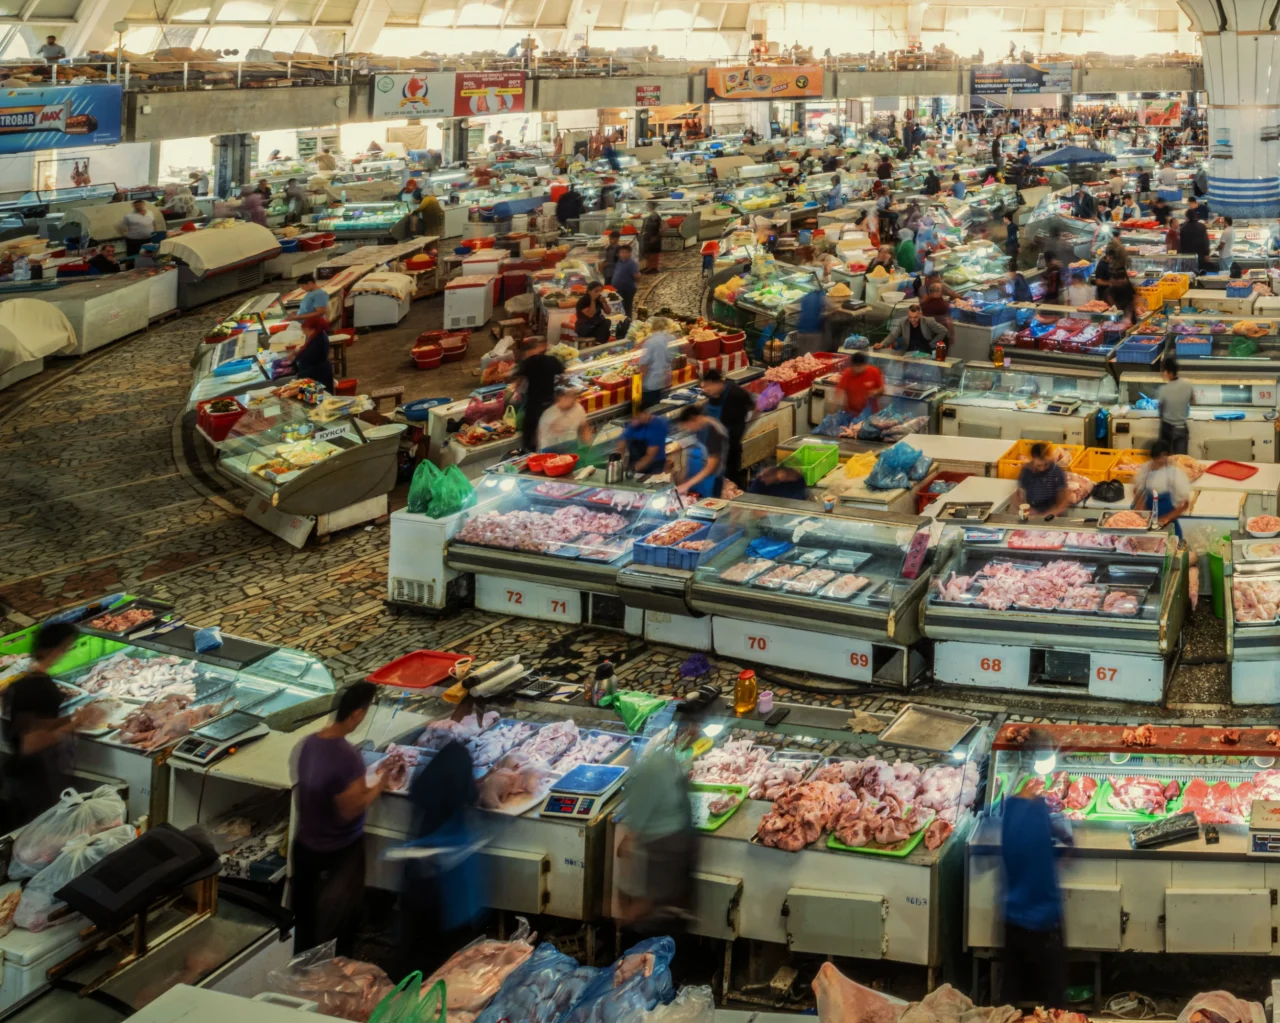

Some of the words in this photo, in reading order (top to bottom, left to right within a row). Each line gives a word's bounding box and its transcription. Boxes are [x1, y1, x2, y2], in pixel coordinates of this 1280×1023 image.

[0, 114, 34, 126] TROBAR
[39, 108, 64, 124] MAX
[320, 427, 346, 439] КУКСИ
[506, 590, 522, 604] 72
[552, 600, 566, 613] 71
[748, 636, 766, 650] 70
[850, 652, 869, 667] 69
[980, 658, 1002, 672] 68
[1096, 667, 1118, 681] 67
